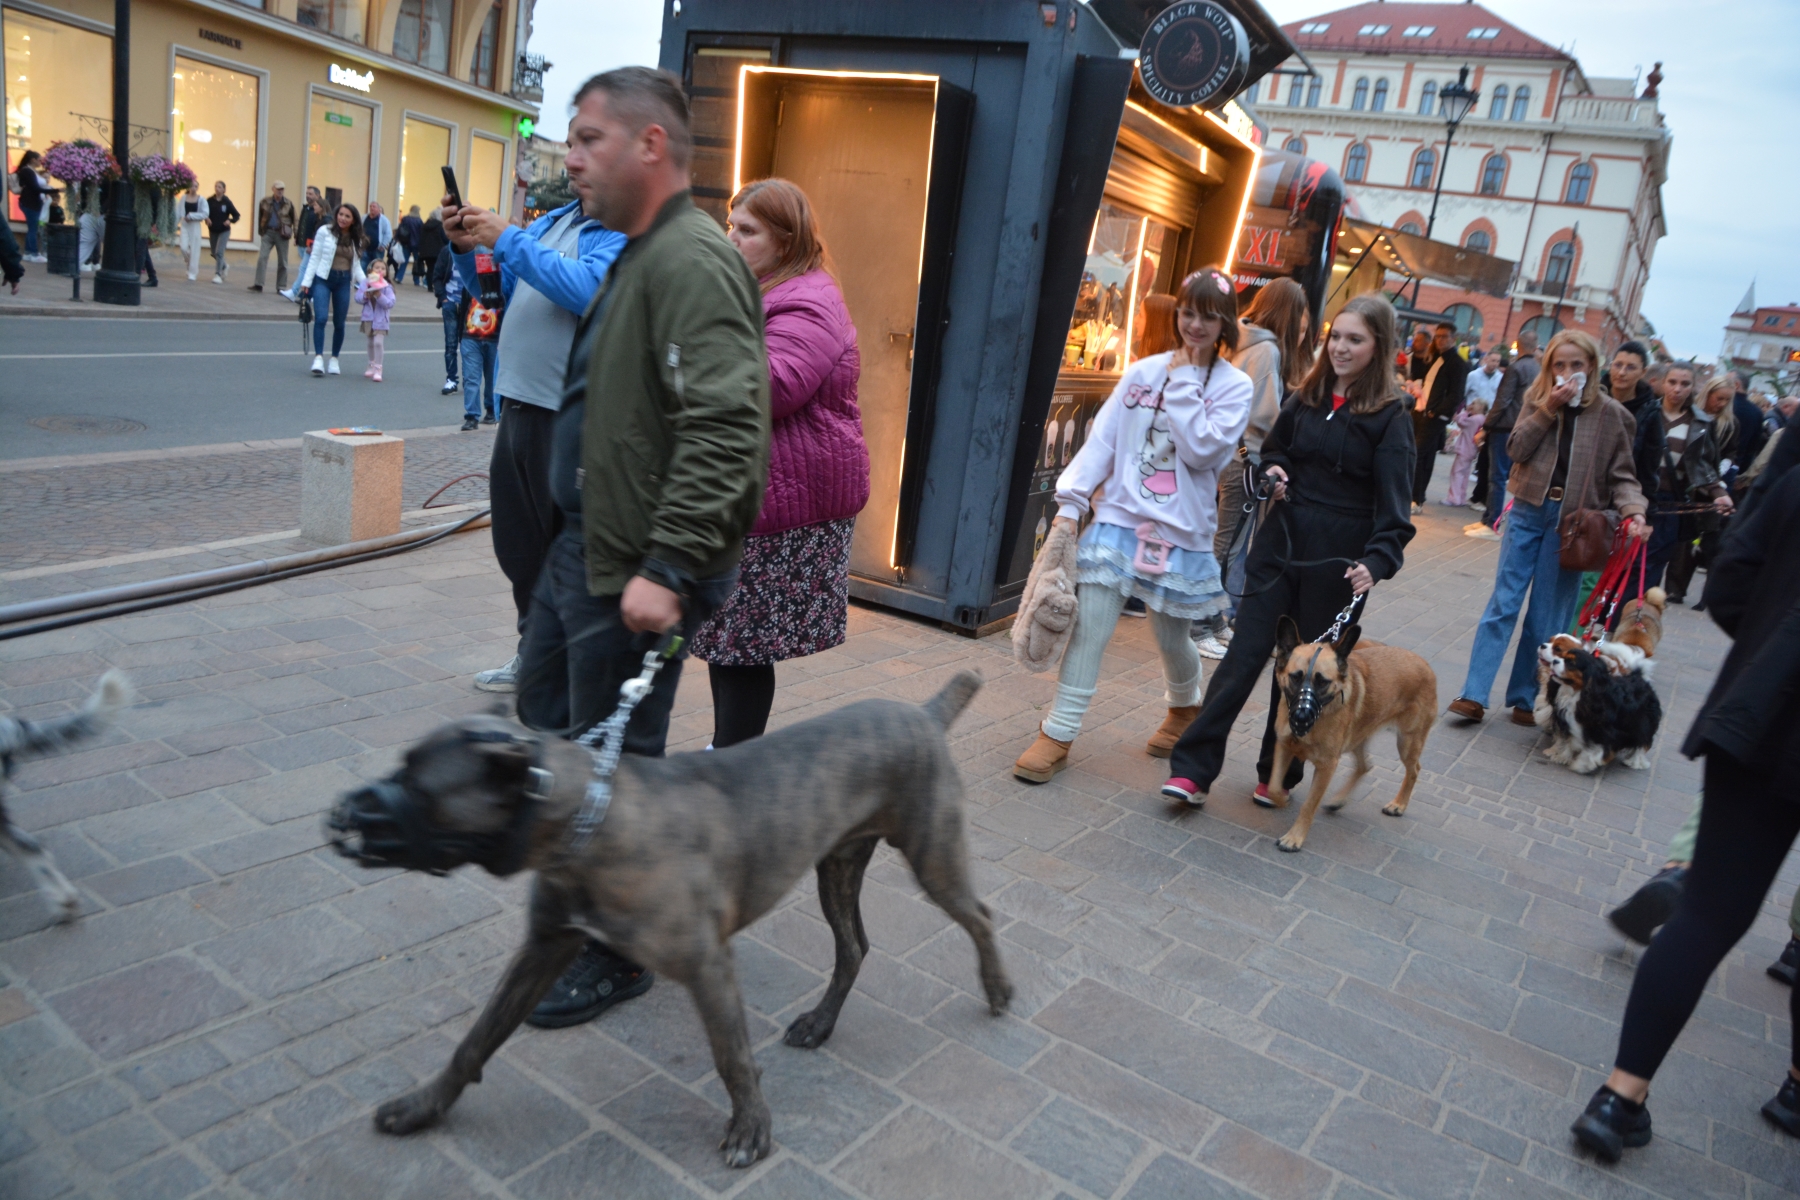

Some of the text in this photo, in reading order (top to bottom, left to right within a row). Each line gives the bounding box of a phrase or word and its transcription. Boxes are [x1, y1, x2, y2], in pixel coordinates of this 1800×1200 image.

[1153, 4, 1233, 38] BLACK WOLF
[1142, 55, 1229, 105] SPECIALTY COFFEE
